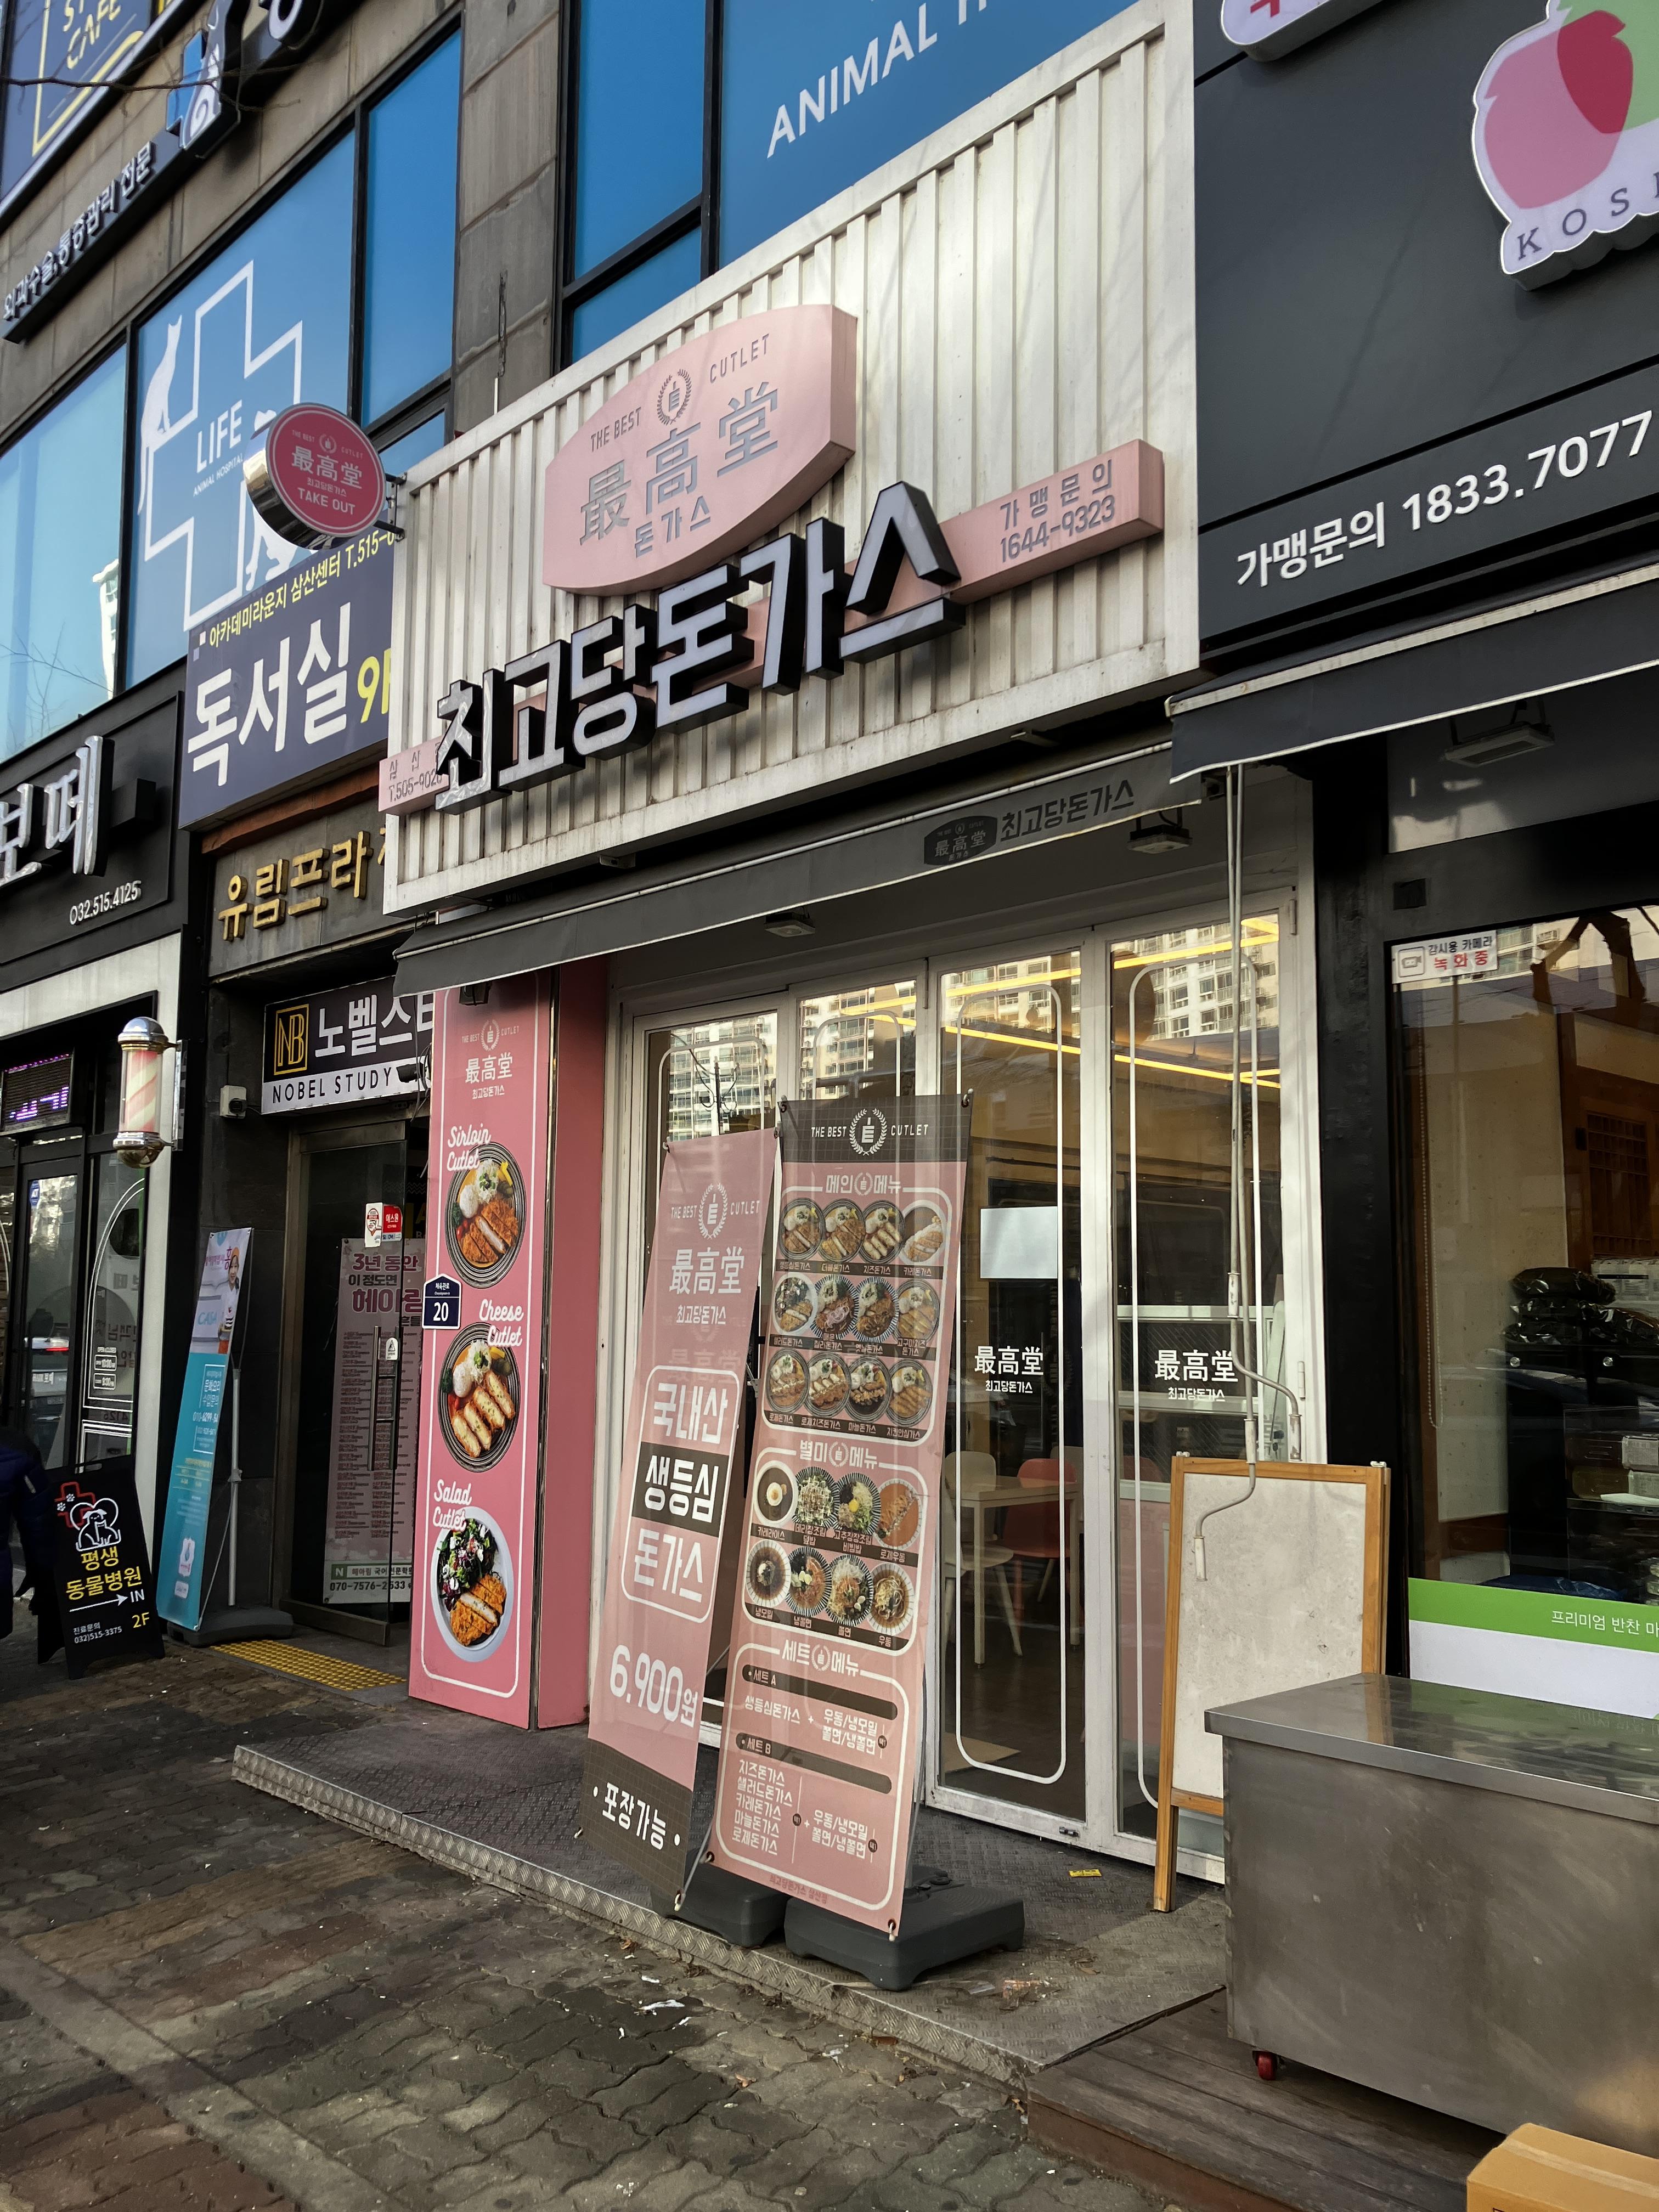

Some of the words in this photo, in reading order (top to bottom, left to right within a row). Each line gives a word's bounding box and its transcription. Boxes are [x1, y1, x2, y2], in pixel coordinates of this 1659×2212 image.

[767, 3, 938, 159] ANIMAL
[121, 141, 154, 197] 전문
[1517, 171, 1659, 260] KOS
[590, 425, 610, 452] THE
[614, 407, 642, 439] BEST
[709, 334, 769, 383] CUTLET
[197, 399, 242, 473] LIFE
[292, 445, 362, 489] 最高堂
[341, 447, 363, 459] CUTLET
[579, 382, 778, 545] 最高堂
[193, 474, 215, 497] ANIMAL
[216, 453, 243, 479] HOSPITAL
[297, 487, 329, 507] TAKE
[332, 498, 356, 515] OUT
[1000, 459, 1112, 531] 가맹문의
[1237, 501, 1385, 588] 가맹문의
[1402, 410, 1653, 531] 1833.7077
[634, 495, 711, 558] 돈가스
[1000, 494, 1115, 563] 1644-9323
[210, 584, 287, 647] 아카데미라운지
[290, 550, 341, 603] 삼산센터
[435, 481, 964, 814] 최고당돈가스
[188, 602, 351, 786] 독서실
[1000, 780, 1135, 842] 최고당돈가스
[934, 830, 987, 857] 最高堂
[69, 880, 142, 926] 032.515.4125
[1428, 941, 1458, 956] 감시용
[470, 1033, 480, 1042] BEST
[501, 1025, 520, 1036] CUTLET
[465, 1052, 513, 1084] 最高堂
[273, 1079, 325, 1104] NOBEL
[335, 1066, 393, 1094] STUDY
[472, 1085, 505, 1099] 최고당돈가스
[448, 1124, 492, 1148] Sirloin
[811, 1126, 825, 1138] THE
[827, 1126, 847, 1137] BEST
[890, 1124, 929, 1136] CUTLET
[447, 1148, 481, 1171] Cutlet
[826, 1174, 854, 1194] 메인
[873, 1174, 901, 1194] 메뉴
[671, 1206, 681, 1219] THE
[682, 1205, 698, 1218] BEST
[730, 1200, 760, 1215] CUTLET
[353, 1253, 381, 1272] 3년
[385, 1255, 419, 1272] 동안
[669, 1246, 745, 1295] 最高堂
[822, 1262, 850, 1273] 더블돈가스
[863, 1265, 891, 1276] 치즈돈가스
[904, 1266, 932, 1277] 카레돈가스
[348, 1274, 360, 1286] 이
[363, 1274, 397, 1286] 정도면
[433, 1302, 449, 1322] 20
[479, 1299, 524, 1322] Cheese
[676, 1305, 726, 1325] 최고당돈가스
[487, 1325, 523, 1347] Cutlet
[855, 1344, 884, 1355] 옛날돈가스
[902, 1347, 919, 1356] 돈가스
[974, 1346, 1044, 1375] 最高堂
[1154, 1349, 1239, 1382] 最高堂
[985, 1380, 1033, 1393] 최고당돈가스
[1167, 1387, 1226, 1402] 최고당돈가스
[653, 1382, 729, 1444] 국내산
[801, 1417, 842, 1430] 로제치즈돈가스
[800, 1440, 827, 1463] 별미
[849, 1446, 878, 1470] 메뉴
[434, 1479, 472, 1506] Salad
[645, 1455, 719, 1523] 생등심
[433, 1506, 467, 1532] Cutlet
[757, 1526, 786, 1541] 카레라이스
[795, 1522, 826, 1537] 데리장조림
[833, 1530, 873, 1545] 고추장장조림
[880, 1549, 905, 1563] 로제우동
[843, 1543, 862, 1555] 비빔밥
[81, 1546, 120, 1571] 평생
[634, 1527, 704, 1603] 돈가스
[65, 1566, 143, 1601] 동물병원
[130, 1588, 145, 1602] IN
[73, 1622, 101, 1635] 진료문의
[74, 1626, 123, 1644] 032)515-3375
[132, 1612, 150, 1629] 2F
[755, 1607, 774, 1620] 냉모밀
[838, 1626, 851, 1638] 쫄면
[879, 1635, 892, 1647] 우동
[1551, 1610, 1606, 1631] 프리미엄
[1612, 1617, 1640, 1635] 반찬
[782, 1639, 811, 1666] 세트
[831, 1650, 859, 1677] 메뉴
[610, 1644, 698, 1728] 6.900원
[753, 1669, 769, 1683] 세트
[770, 1674, 776, 1686] A
[744, 1695, 800, 1724] 생등심돈가스
[823, 1708, 878, 1737] 우동/냉모밀
[747, 1737, 763, 1752] 세트
[765, 1743, 771, 1755] B
[822, 1725, 876, 1755] 쫄면/냉쫄면
[738, 1759, 785, 1787] 치즈돈가스
[737, 1776, 793, 1807] 샐러드돈가스
[602, 1781, 667, 1850] 포장가능
[736, 1792, 781, 1821] 카레돈가스
[734, 1809, 780, 1838] 마늘돈가스
[814, 1809, 868, 1841] 우동/냉모밀
[732, 1826, 778, 1856] 로제돈가스
[812, 1827, 866, 1859] 쫄면/냉쫄면
